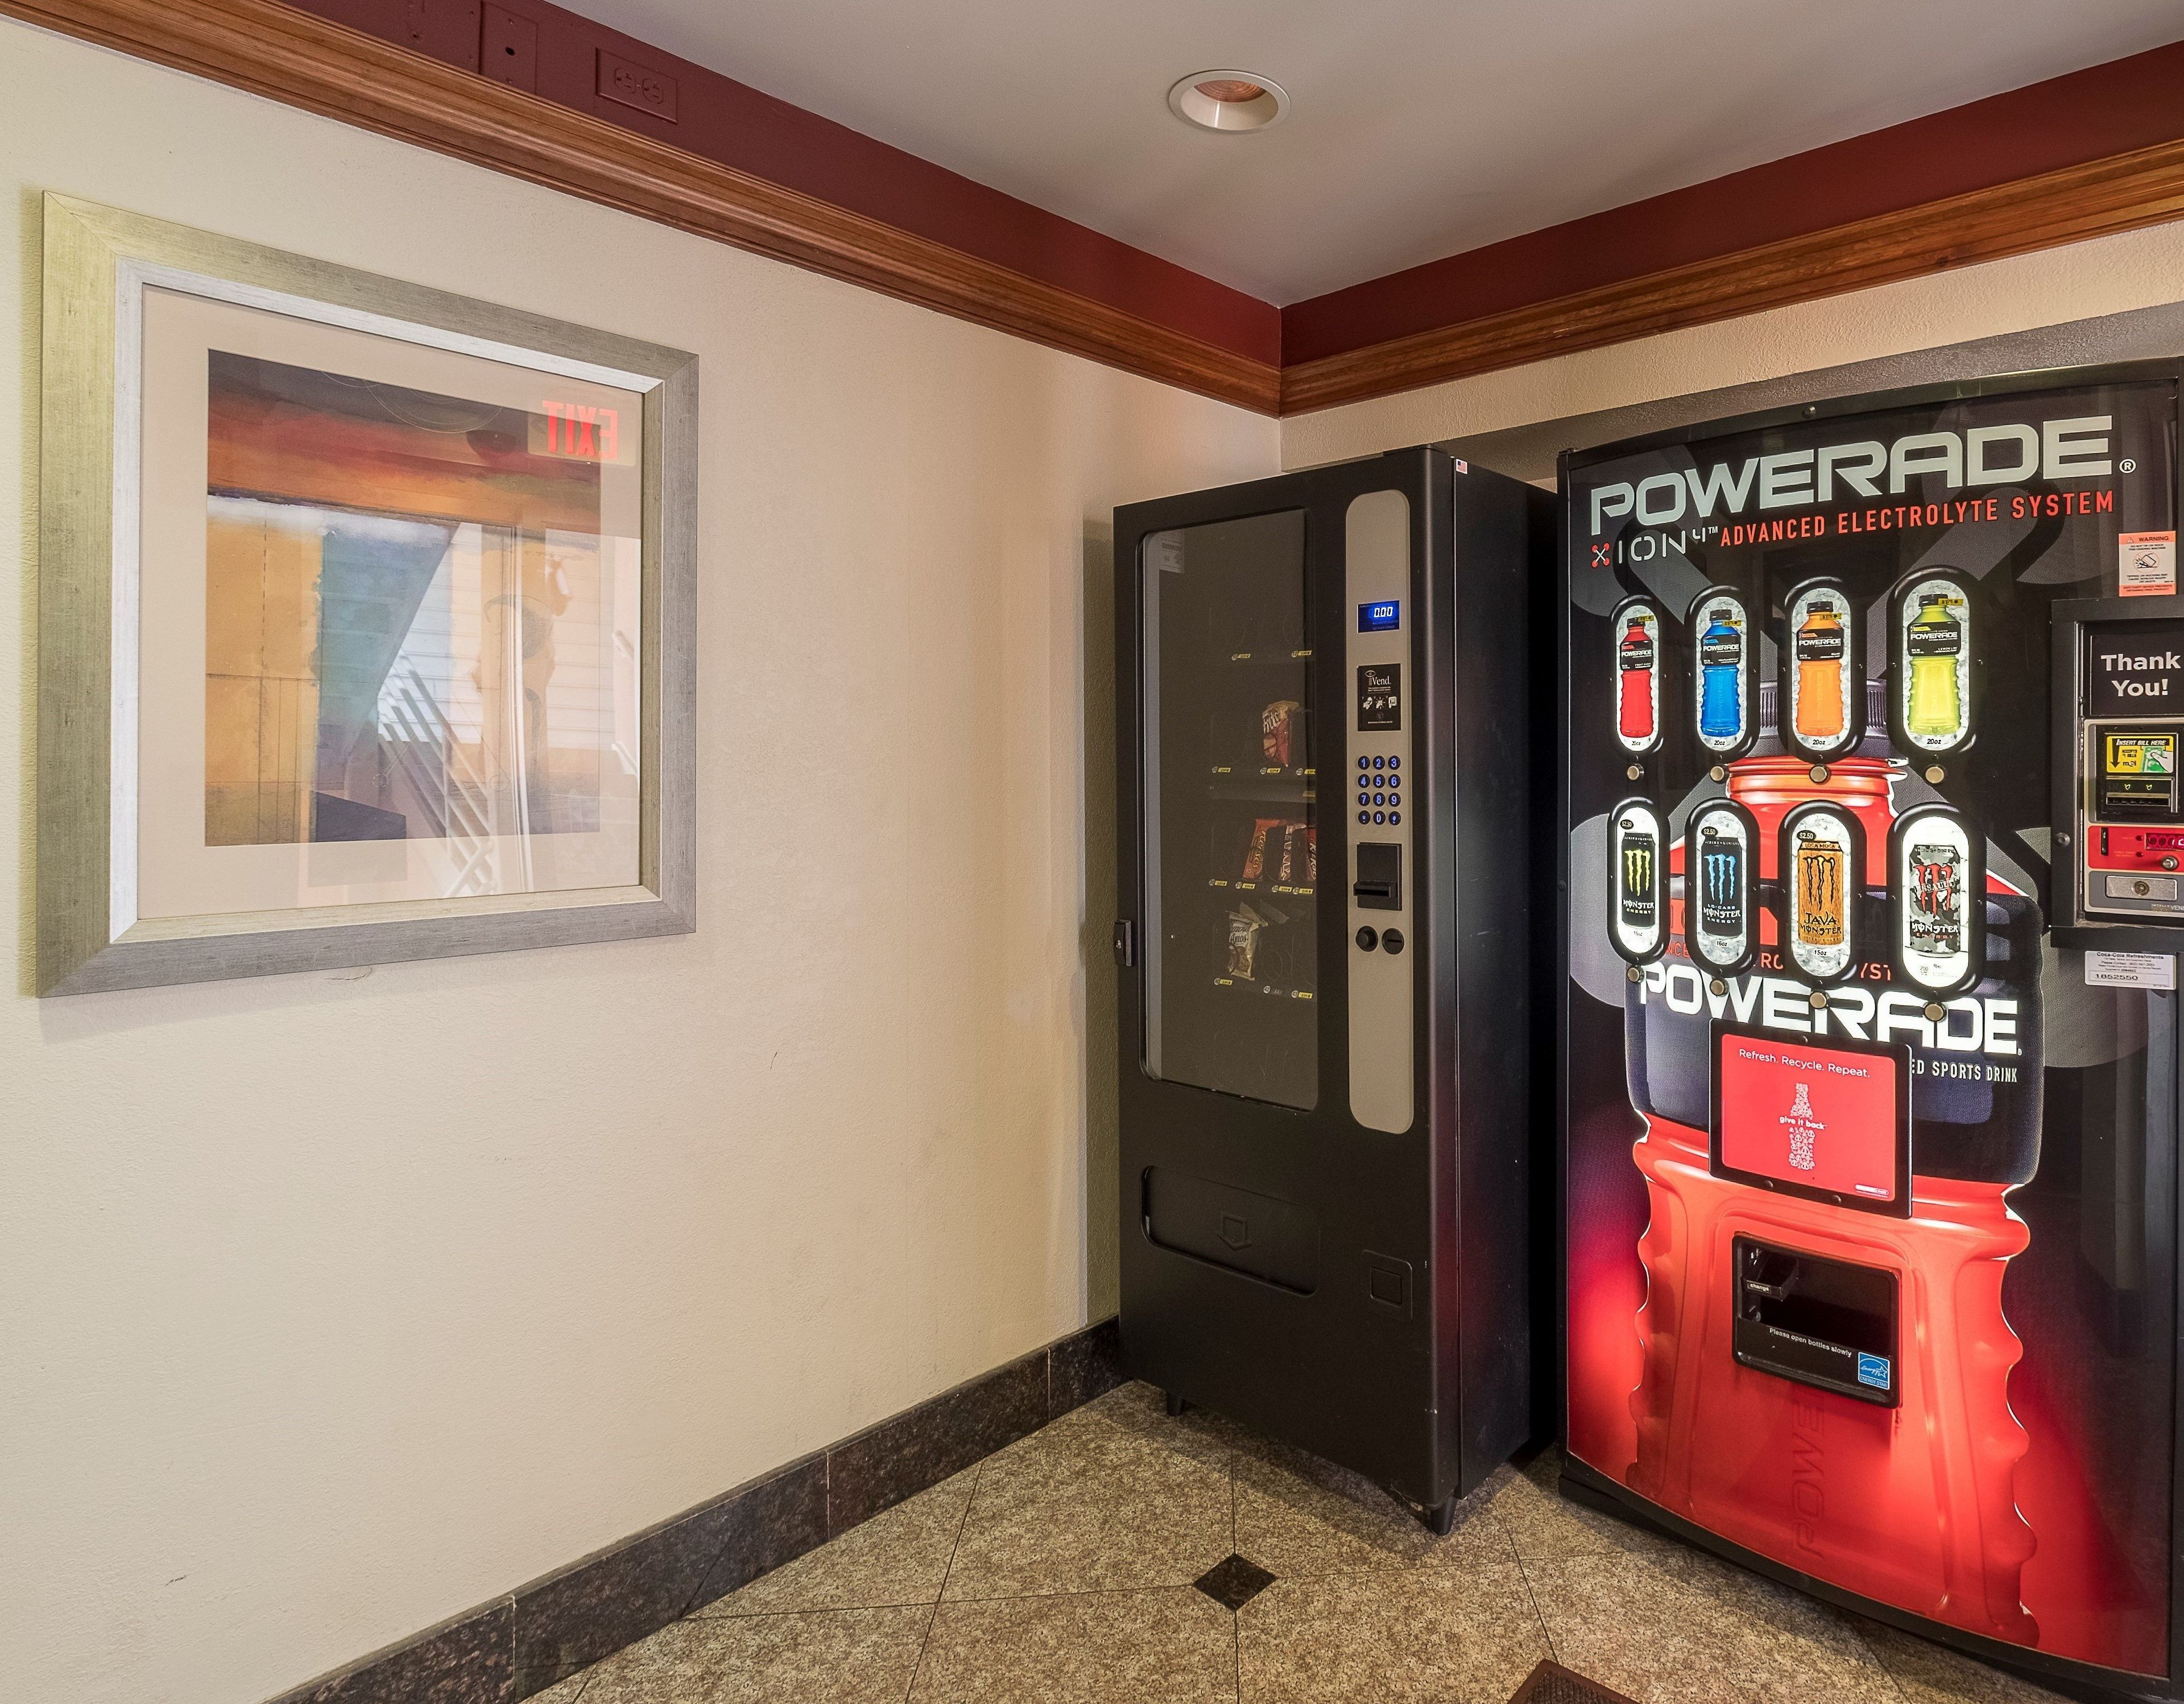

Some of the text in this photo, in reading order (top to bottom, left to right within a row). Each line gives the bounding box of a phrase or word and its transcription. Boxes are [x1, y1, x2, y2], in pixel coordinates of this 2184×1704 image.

[1591, 415, 2112, 536] POWERADE
[1720, 515, 1825, 547] ADVANCED
[1838, 499, 1998, 533] ELECTROLYTE
[2012, 490, 2113, 519] SYSTEM
[1910, 631, 1958, 640] POWERADE
[1703, 643, 1739, 652] POWERADE
[2100, 651, 2181, 671] Thank
[2111, 679, 2168, 697] You!
[1361, 758, 1397, 767] 1 2 3
[1360, 776, 1397, 786] 4 5 6
[1361, 795, 1397, 805] 7 8 9
[1376, 814, 1381, 822] 0
[1623, 899, 1654, 909] MONSTER
[1703, 907, 1741, 919] MONSTER
[1804, 911, 1836, 925] JAVA
[1800, 924, 1842, 936] MONSTER
[1912, 922, 1959, 934] MONSTER
[1640, 964, 2018, 1054] POWERADE
[1739, 1049, 1871, 1078] Refresh. Recycle. Repeat.
[1931, 1061, 1981, 1081] SPORTS
[1986, 1065, 2017, 1083] DRINK
[1778, 1116, 1825, 1130] give it back
[1749, 1283, 1769, 1292] change
[1769, 1327, 1852, 1358] Please open bottles slowly
[1860, 1376, 1876, 1384] ENERGY
